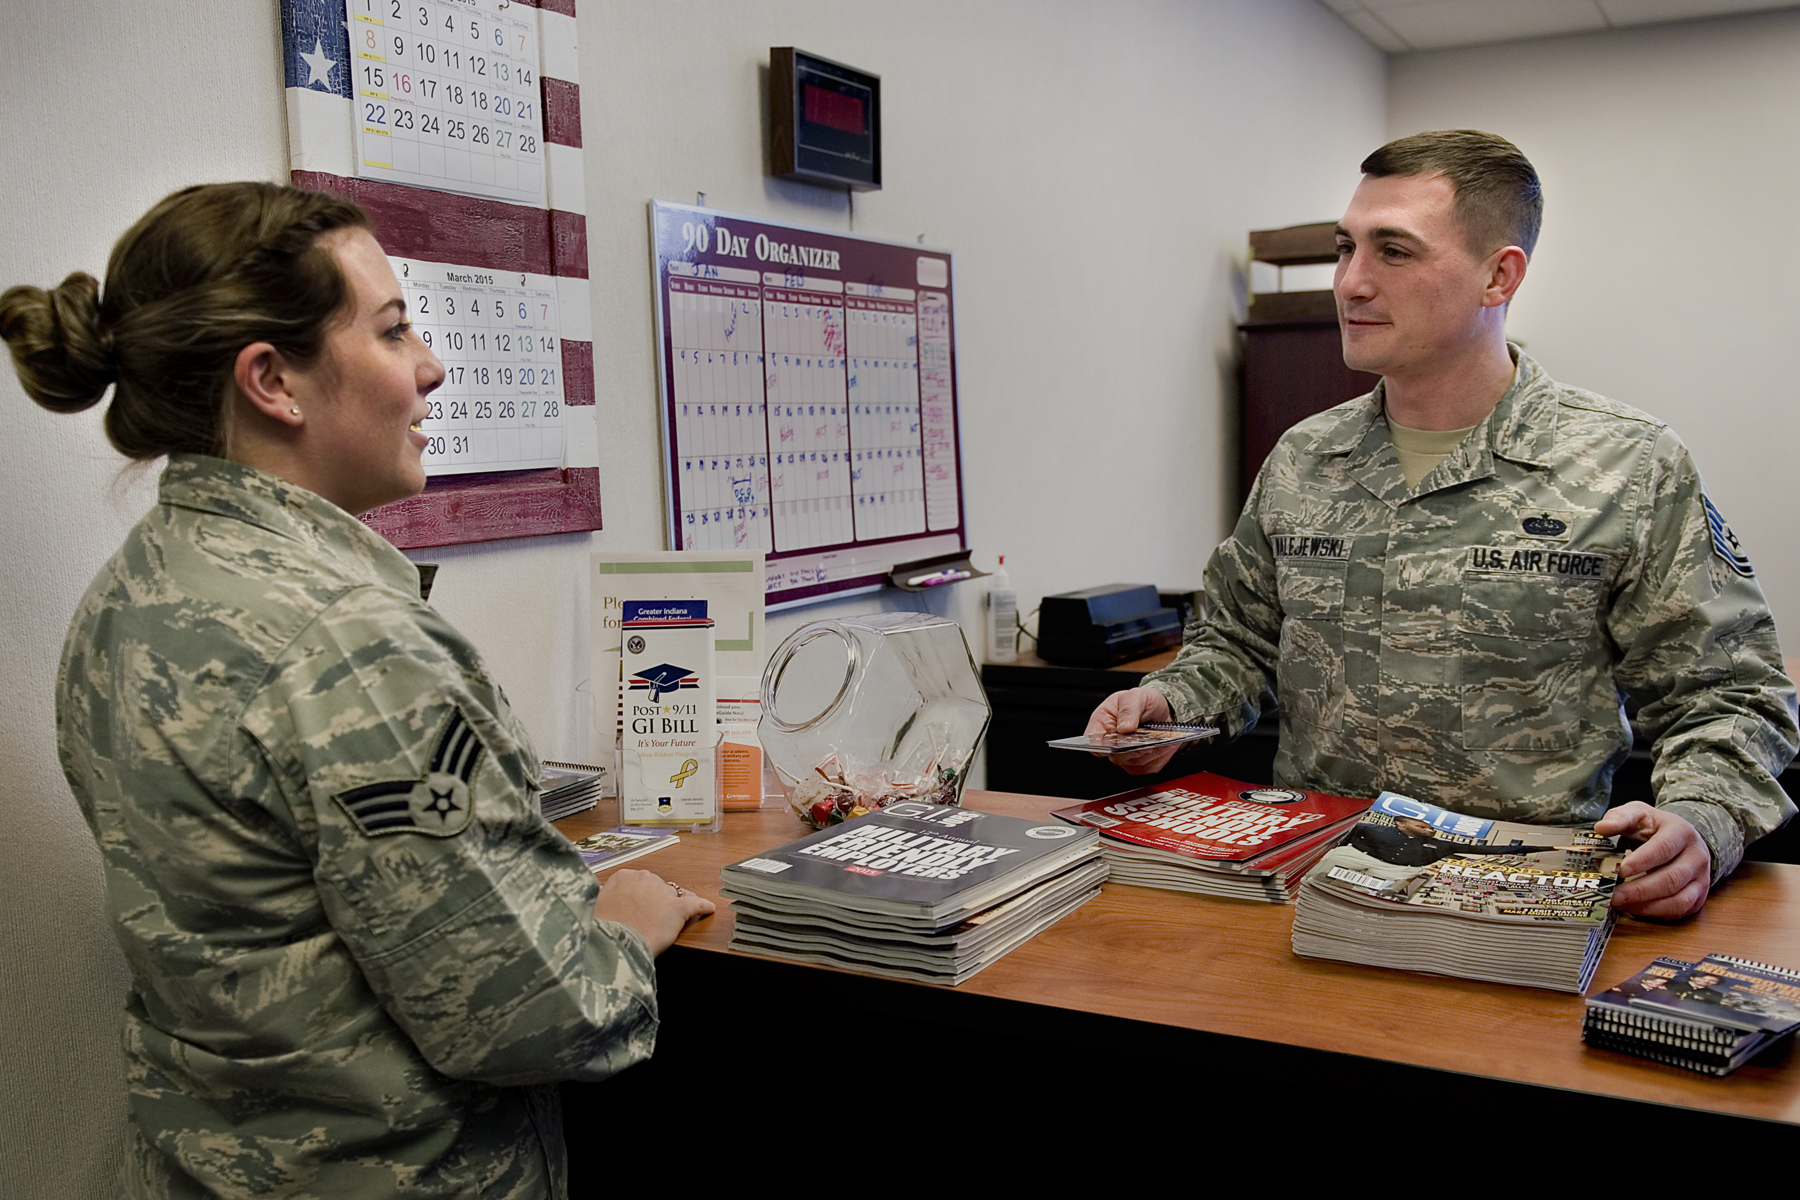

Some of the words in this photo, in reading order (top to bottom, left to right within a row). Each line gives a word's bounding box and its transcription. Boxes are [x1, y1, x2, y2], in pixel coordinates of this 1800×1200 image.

[391, 0, 402, 19] 2
[419, 7, 428, 26] 3
[445, 15, 454, 32] 4
[471, 22, 480, 40] 5
[494, 28, 504, 46] 6
[518, 34, 526, 52] 7
[366, 30, 376, 48] 8
[394, 36, 404, 56] 9
[417, 42, 435, 63] 10
[444, 49, 459, 70] 11
[469, 56, 486, 76] 12
[493, 62, 509, 82] 13
[516, 68, 532, 87] 14
[364, 66, 384, 88] 15
[392, 72, 412, 94] 16
[420, 78, 436, 98] 17
[446, 84, 464, 104] 18
[471, 90, 488, 110] 18
[494, 96, 511, 116] 20
[518, 101, 532, 120] 21
[366, 103, 386, 124] 22
[394, 108, 414, 130] 23
[421, 114, 440, 134] 24
[447, 119, 466, 140] 25
[472, 124, 490, 144] 26
[496, 130, 512, 148] 27
[519, 134, 536, 154] 28
[682, 222, 709, 254] 90
[715, 226, 750, 258] DAY
[755, 233, 840, 271] ORGANIZER
[413, 282, 430, 290] Monday
[439, 284, 456, 292] Tuesday
[462, 286, 484, 294] Wednesday
[446, 272, 472, 284] March
[474, 274, 494, 286] 2015
[419, 296, 430, 314] 2
[446, 298, 456, 315] 3
[471, 300, 480, 316] 4
[495, 302, 504, 318] 5
[518, 302, 527, 319] 6
[540, 304, 548, 320] 7
[422, 331, 432, 348] 9
[446, 332, 462, 350] 10
[471, 334, 486, 350] 11
[494, 334, 510, 352] 12
[518, 336, 533, 352] 13
[540, 336, 554, 352] 14
[448, 367, 464, 384] 17
[473, 368, 490, 385] 18
[496, 368, 512, 385] 19
[519, 368, 535, 385] 20
[542, 369, 556, 385] 21
[426, 402, 442, 420] 23
[450, 402, 468, 419] 24
[475, 402, 492, 418] 25
[498, 401, 516, 418] 26
[522, 401, 536, 418] 27
[544, 401, 559, 418] 28
[428, 436, 446, 454] 30
[453, 436, 468, 454] 31
[1472, 548, 1505, 570] U.S.
[1508, 550, 1542, 572] AIR
[1547, 552, 1604, 576] FORCE
[672, 704, 697, 715] 9/11
[632, 718, 655, 734] GI
[638, 739, 649, 748] It's
[651, 739, 669, 748] Your
[670, 739, 696, 747] Future
[1128, 798, 1286, 837] FRIENDLY
[1150, 790, 1314, 828] MILITARY
[1170, 788, 1222, 804] 2015
[1222, 800, 1290, 816] GUIDE
[1298, 812, 1326, 820] TO
[1103, 803, 1272, 846] SCHOOLS
[821, 833, 998, 872] FRIENDLY
[850, 824, 1021, 862] MILITARY
[798, 844, 968, 880] EMPLOYERS
[1552, 870, 1602, 880] THE
[1439, 864, 1601, 889] REACTOR
